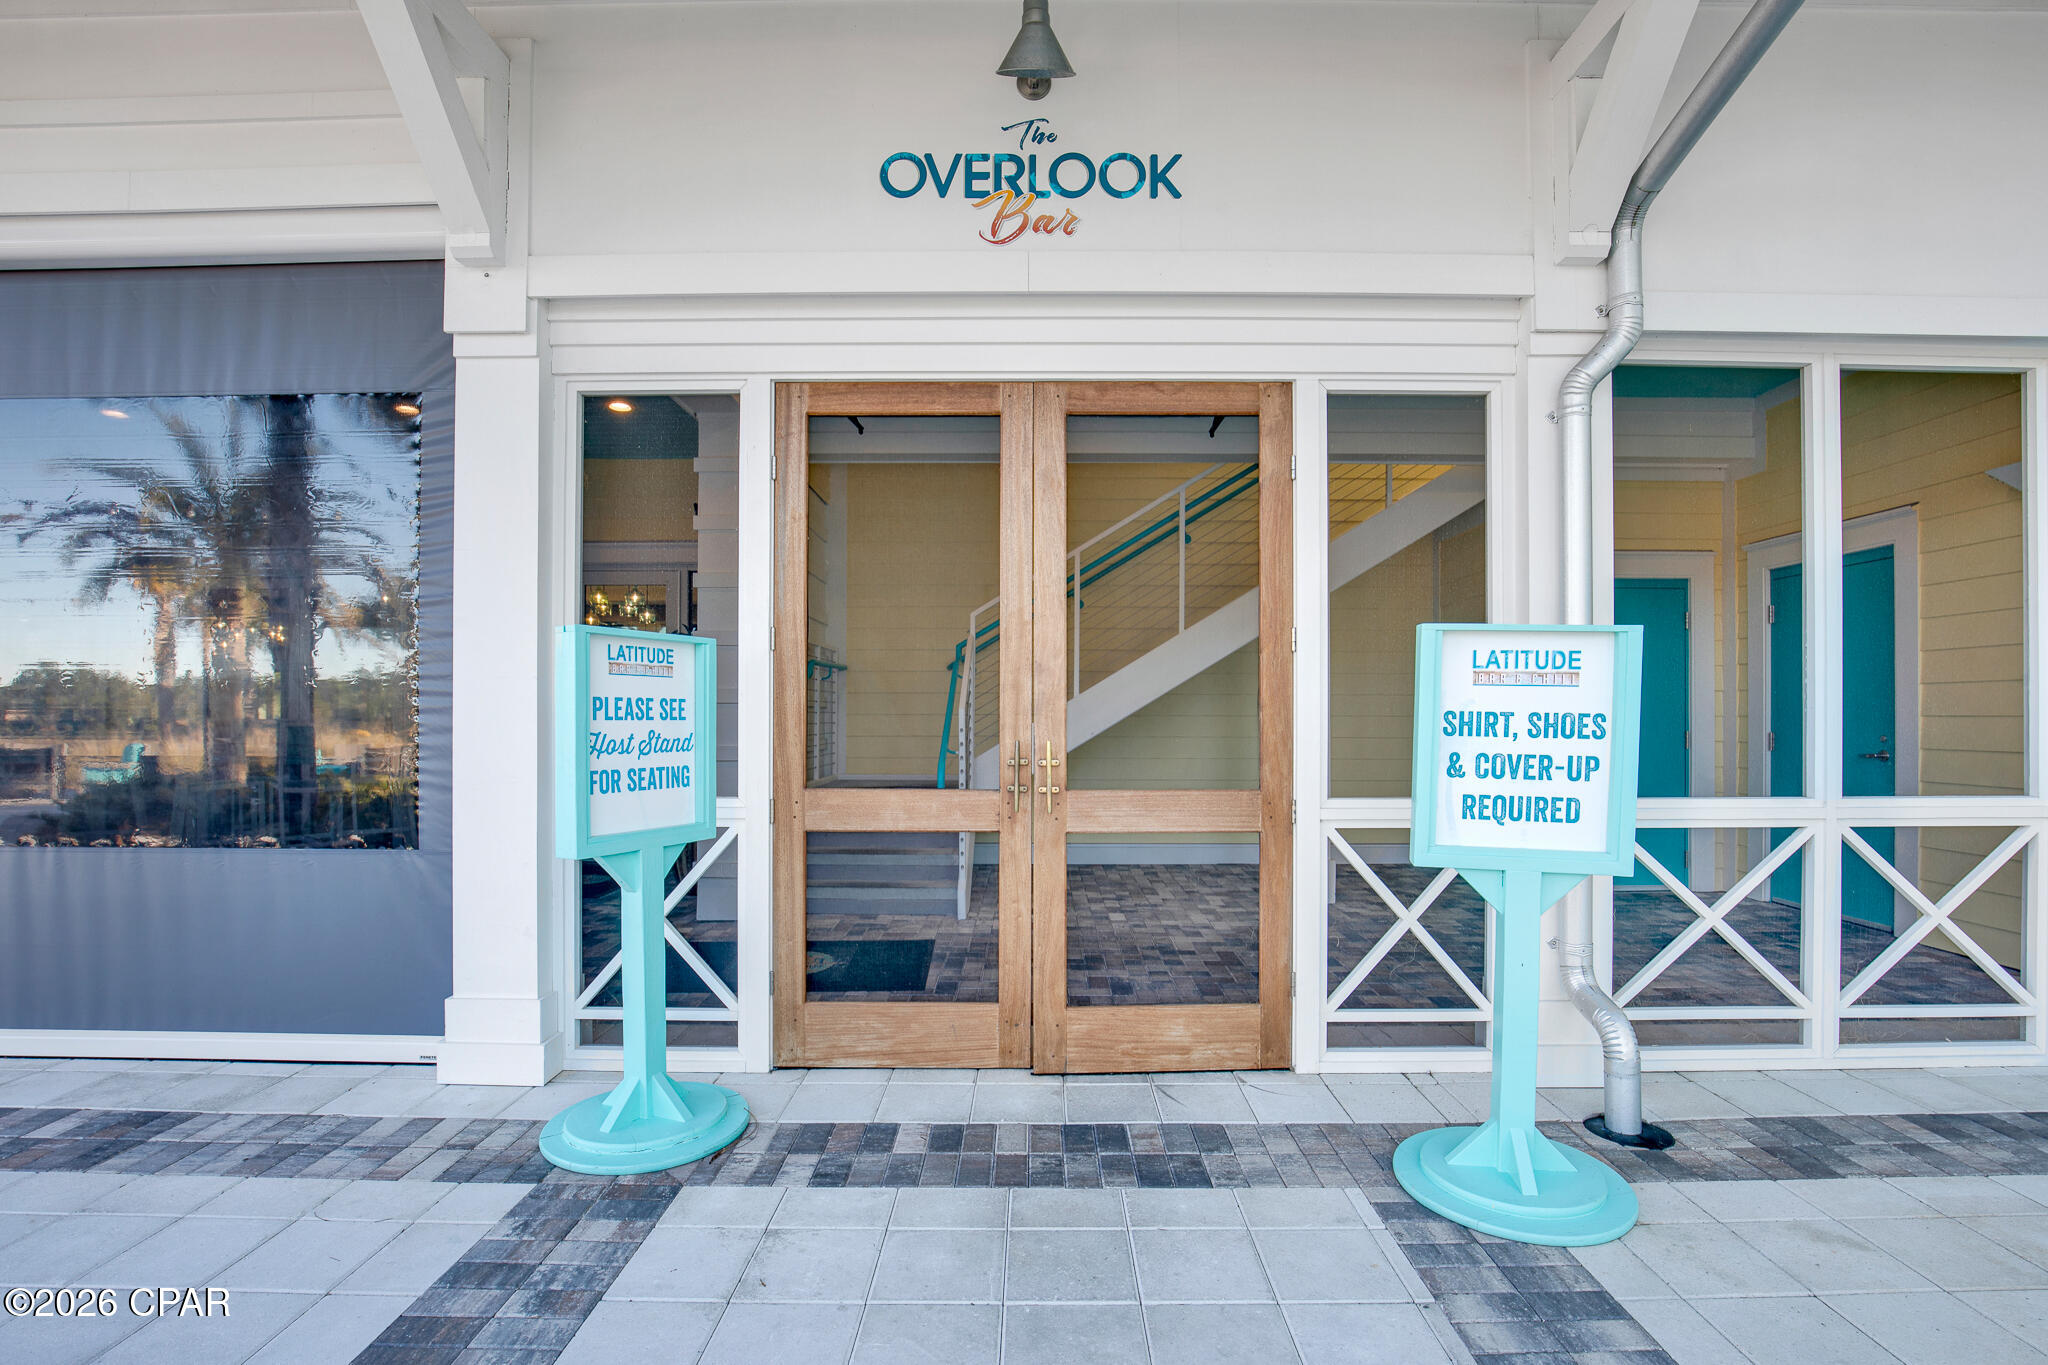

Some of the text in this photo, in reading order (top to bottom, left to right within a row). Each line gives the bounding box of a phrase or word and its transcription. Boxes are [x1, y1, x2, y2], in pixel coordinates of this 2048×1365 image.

[1000, 118, 1058, 150] The
[879, 152, 1183, 199] OVERLOOK
[971, 189, 1080, 245] Bar
[607, 643, 675, 665] LATITUDE
[1472, 649, 1582, 670] LATITUDE
[1477, 673, 1505, 684] BAR
[592, 696, 687, 721] PLEASE SEE
[1442, 711, 1607, 742] SHIRT, SHOES
[589, 729, 694, 760] Host Stand
[590, 765, 690, 795] FOR SEATING
[1446, 752, 1600, 782] & COVER-UP
[1461, 794, 1581, 826] REQUIRED
